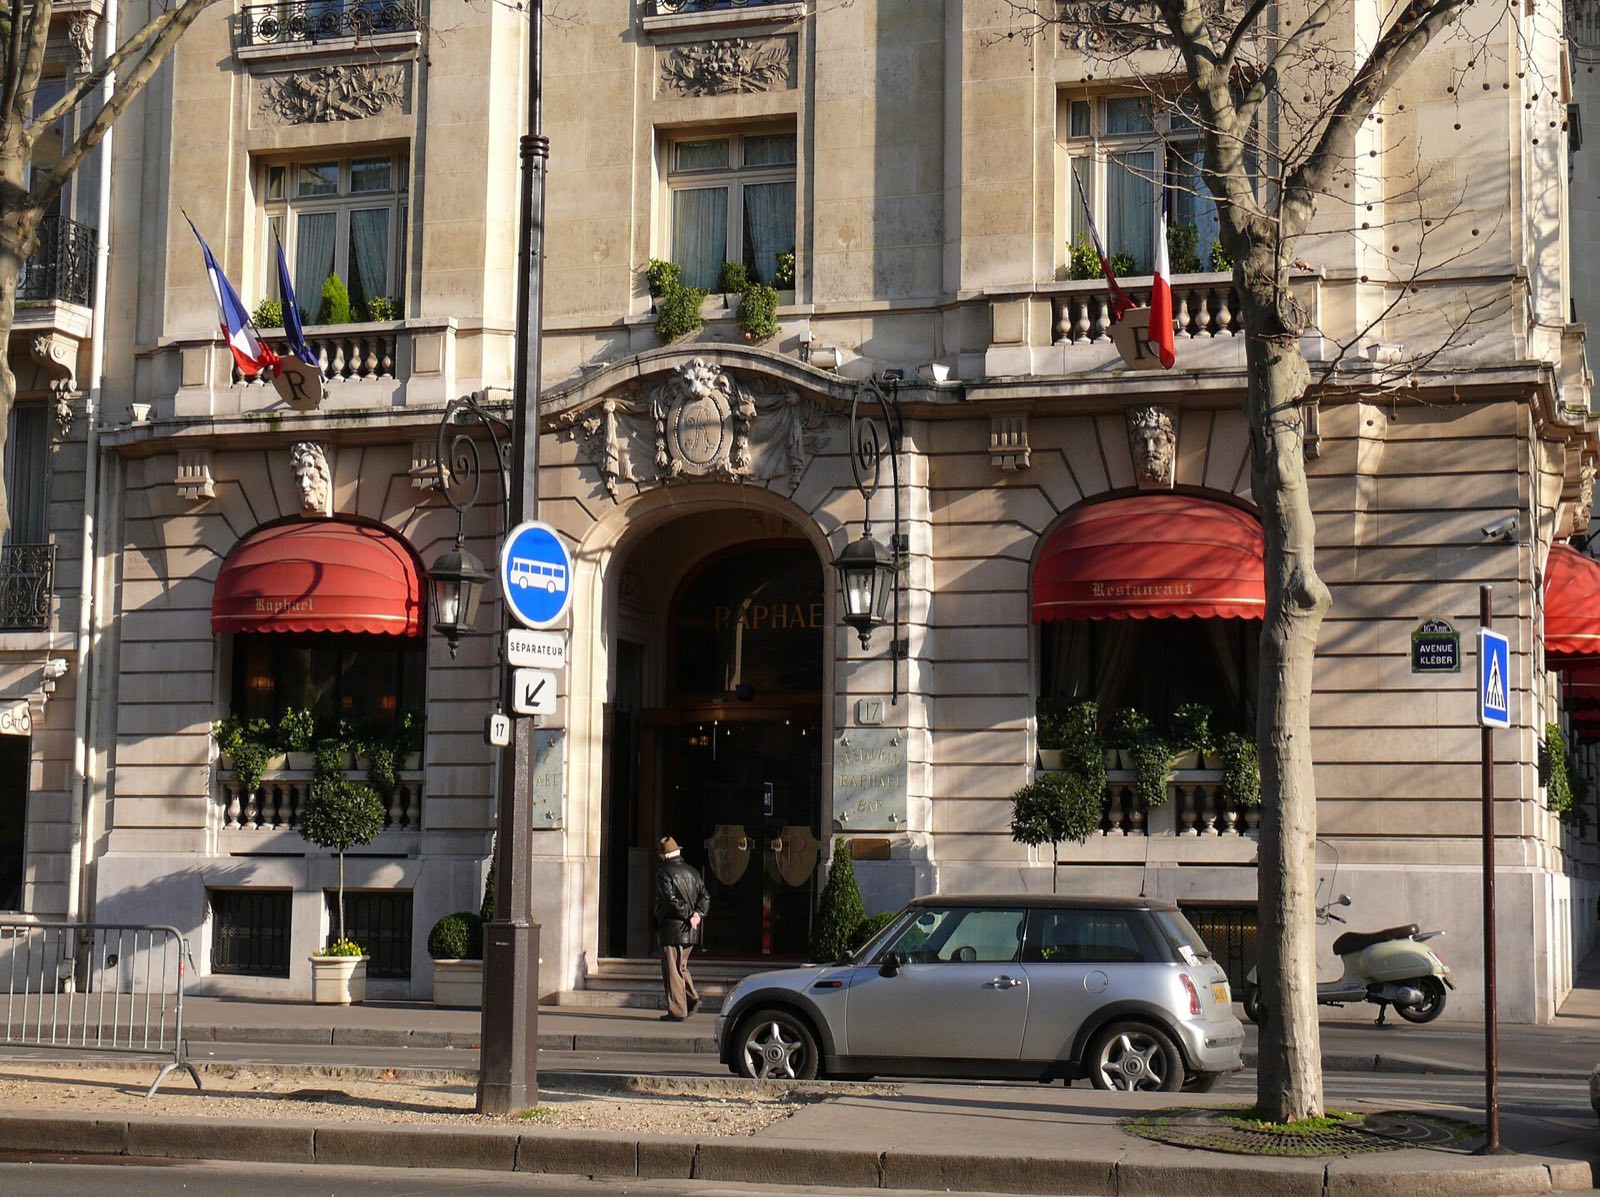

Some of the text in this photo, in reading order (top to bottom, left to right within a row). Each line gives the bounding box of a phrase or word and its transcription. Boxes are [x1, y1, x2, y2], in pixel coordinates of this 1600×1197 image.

[282, 370, 311, 401] R
[1092, 582, 1193, 597] Restaurant
[255, 597, 313, 615] Raphael
[714, 603, 824, 630] RAPHAE
[510, 641, 563, 656] SÉPARATEUR
[1420, 644, 1453, 653] AVENUE
[1420, 655, 1453, 665] KLÉBER
[865, 702, 880, 721] 17
[495, 723, 505, 737] 17
[839, 774, 903, 788] RAPHAEL
